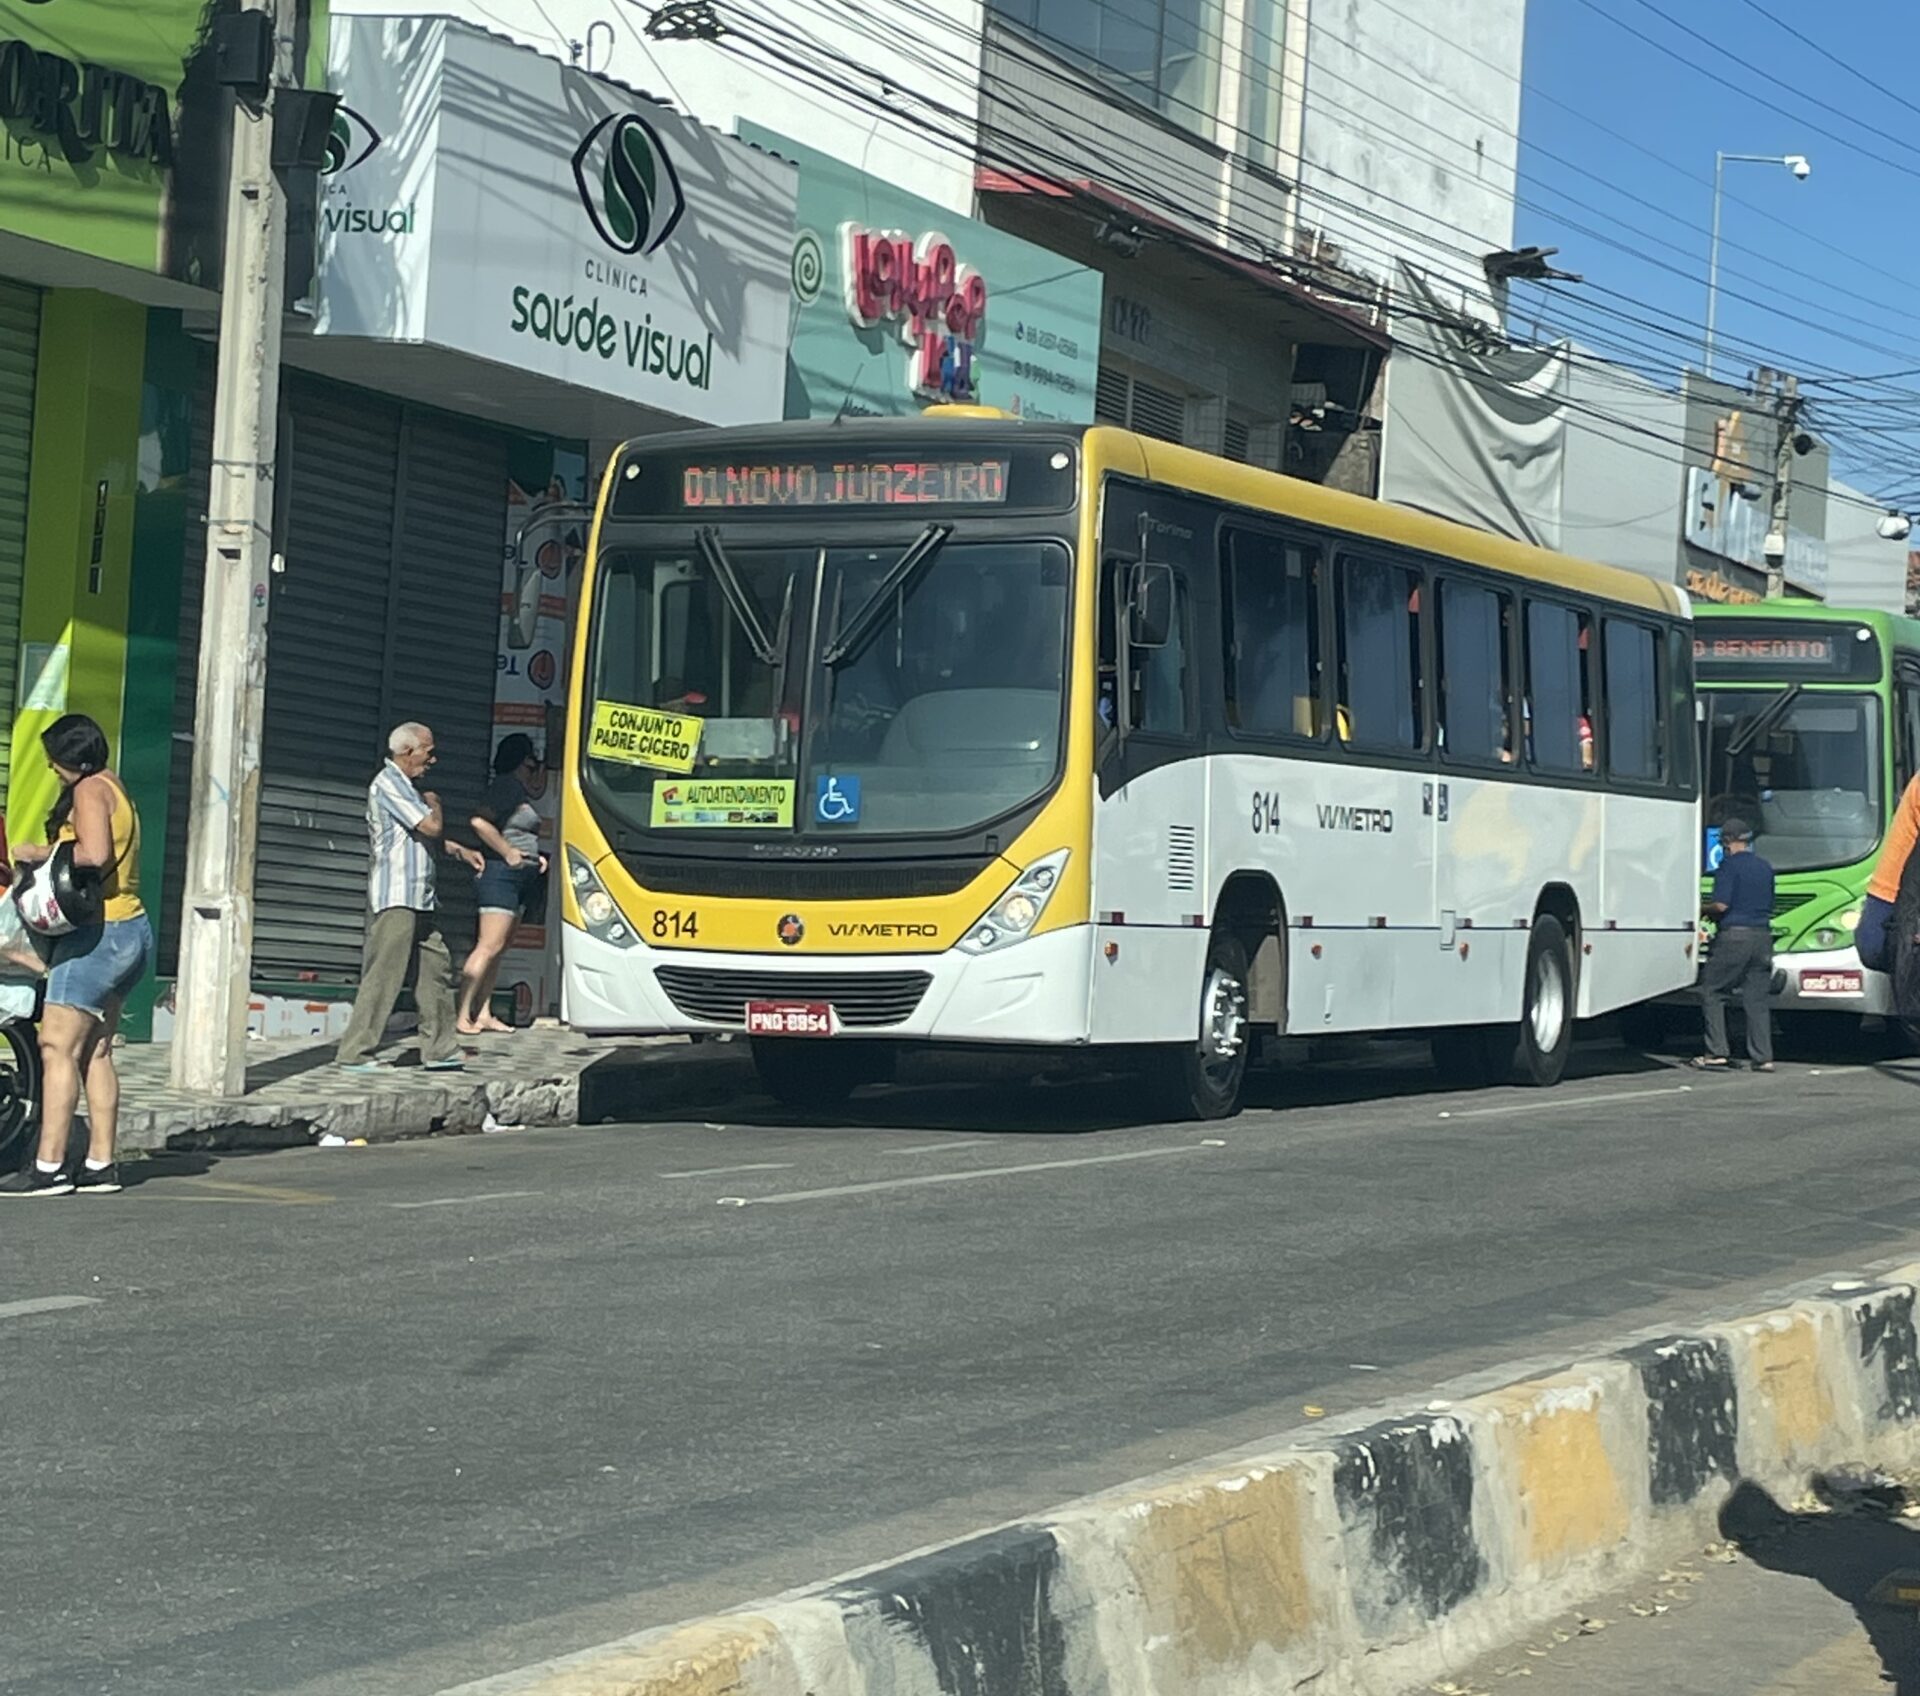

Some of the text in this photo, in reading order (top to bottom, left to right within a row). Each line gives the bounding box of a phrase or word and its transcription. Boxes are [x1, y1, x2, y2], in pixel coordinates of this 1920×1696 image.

[325, 202, 415, 233] visual
[511, 285, 713, 390] saúde visual
[726, 465, 817, 505] NOVO
[825, 462, 1002, 503] JUAZEIRO
[1713, 639, 1825, 658] BENEDITO
[609, 710, 683, 739] CONJUNTO
[594, 728, 690, 761] PADRE CICERO
[686, 785, 786, 806] AUTOATENDIMENTO
[1252, 791, 1280, 834] 814
[653, 910, 698, 938] 814
